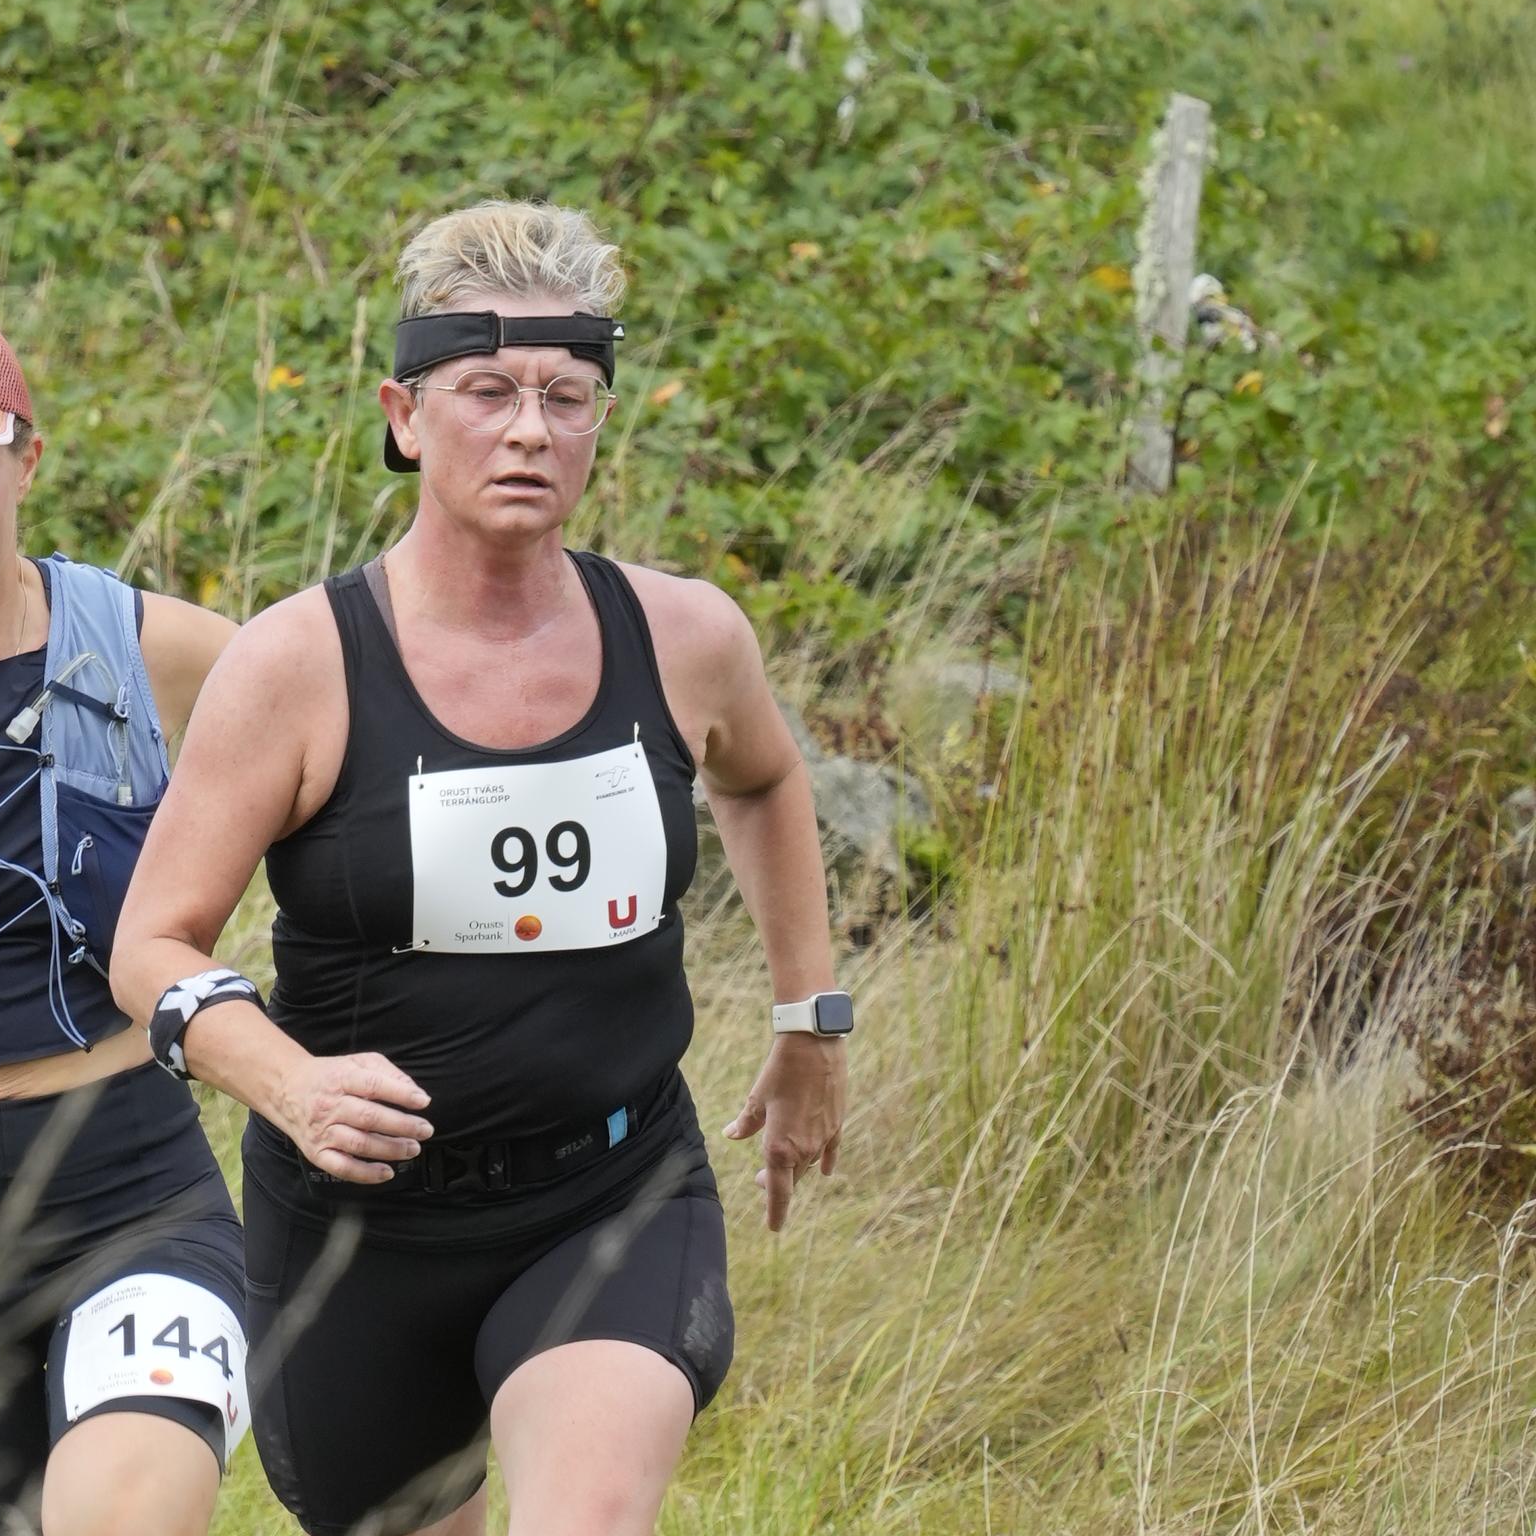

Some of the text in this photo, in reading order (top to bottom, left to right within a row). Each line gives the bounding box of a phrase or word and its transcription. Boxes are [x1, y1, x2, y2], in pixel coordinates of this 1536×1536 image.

[439, 787, 470, 798] ORUST
[490, 820, 591, 899] 99
[468, 921, 505, 931] Orusts
[454, 931, 505, 944] Sparbank
[554, 1133, 594, 1161] SILVA
[108, 1313, 234, 1381] 144
